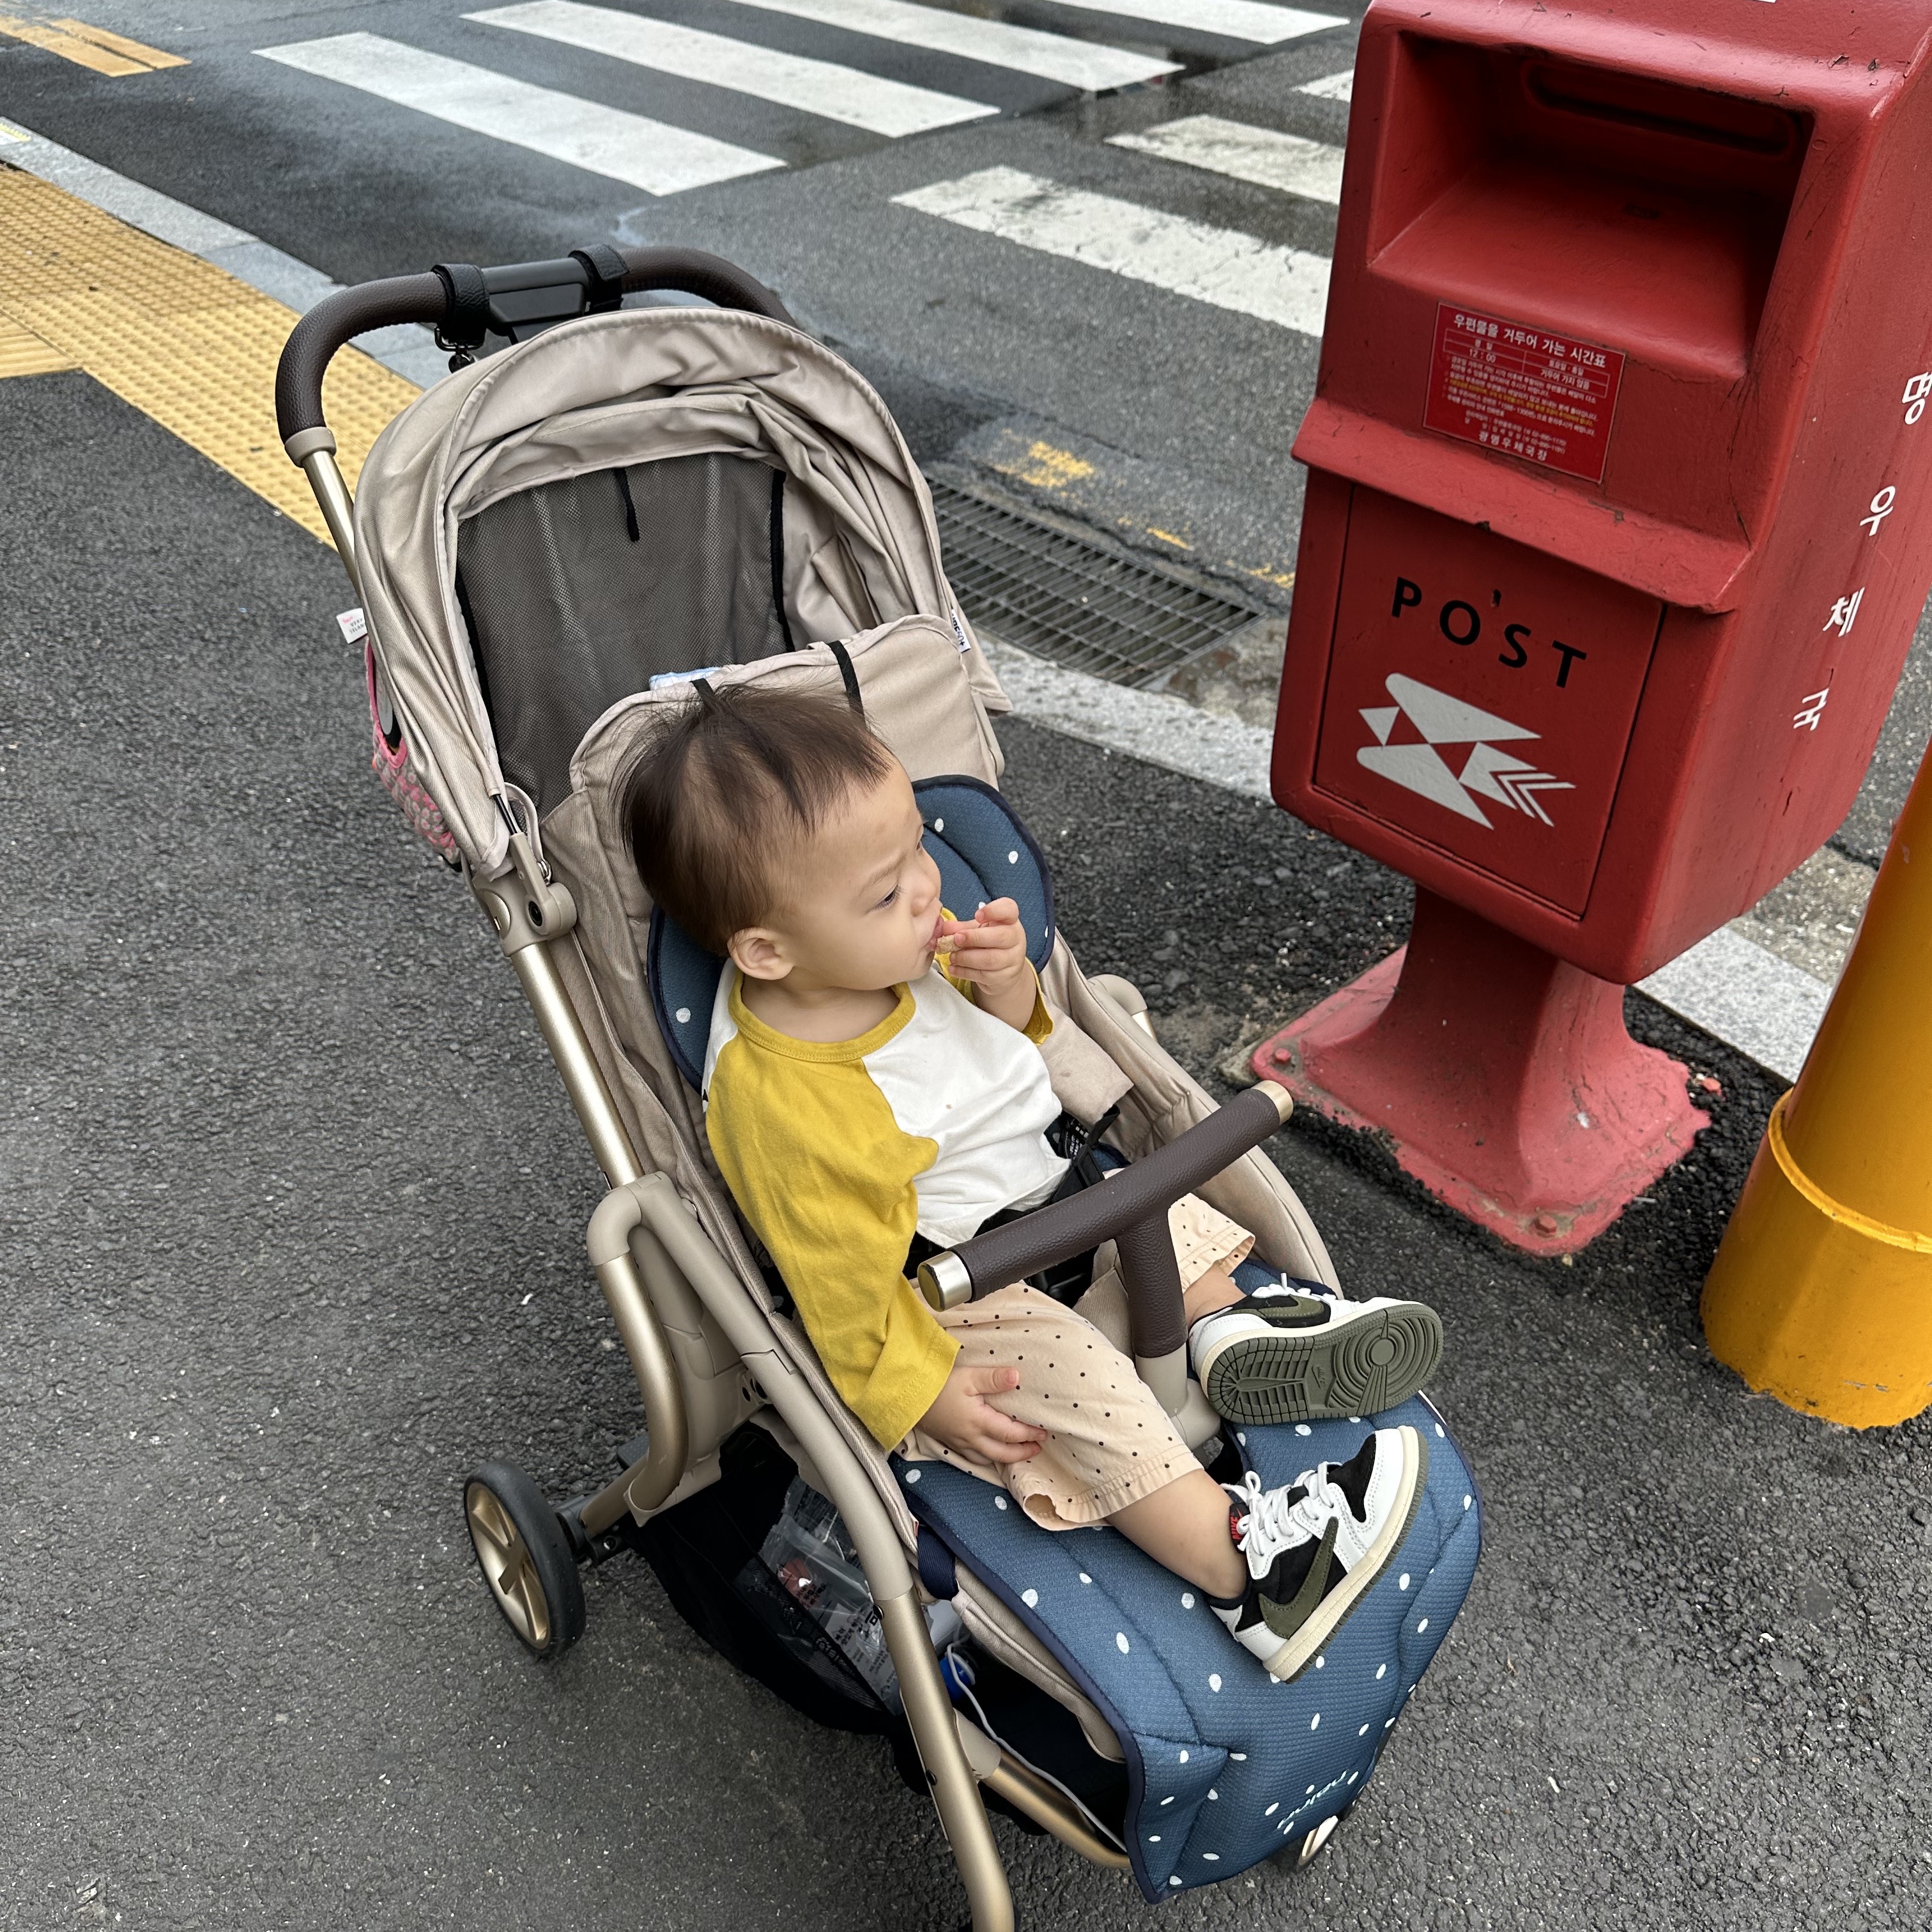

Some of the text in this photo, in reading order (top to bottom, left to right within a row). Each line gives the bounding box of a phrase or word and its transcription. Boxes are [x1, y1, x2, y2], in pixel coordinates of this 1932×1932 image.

[1453, 313, 1607, 369] 우편물을 거두어 가는 시간표
[1540, 369, 1560, 381] 거두어
[1561, 375, 1575, 385] 가지
[1392, 576, 1587, 689] POST
